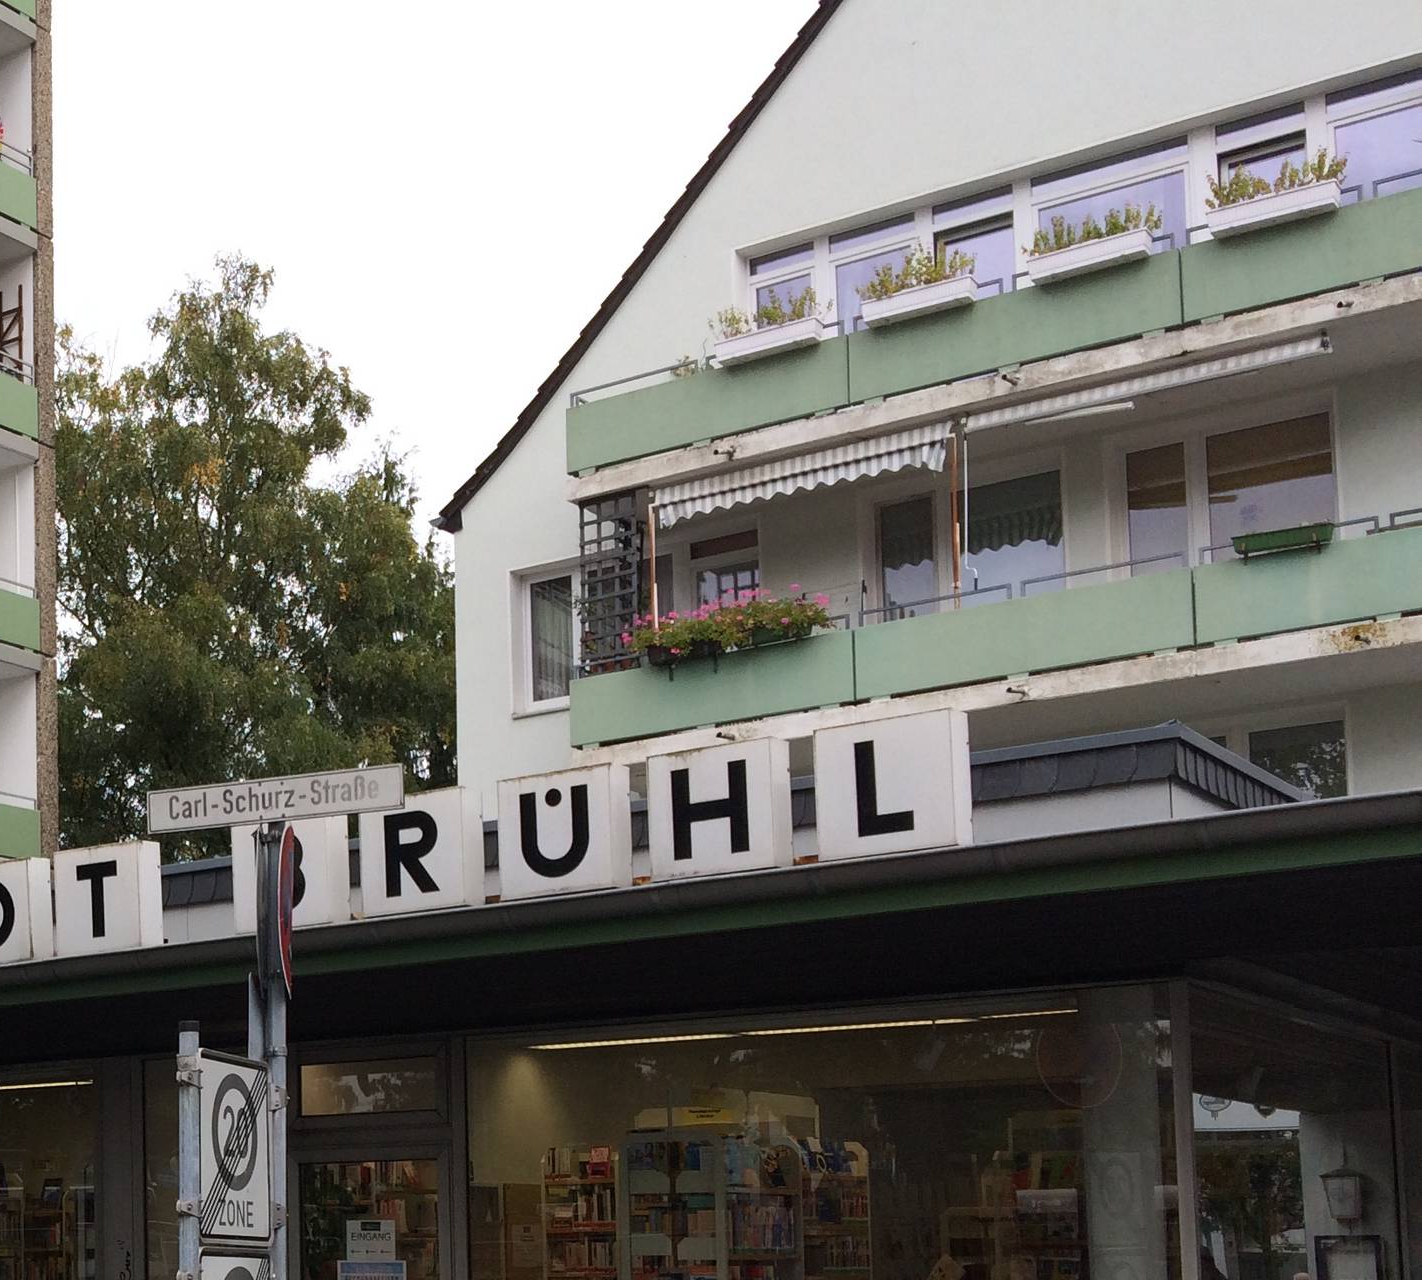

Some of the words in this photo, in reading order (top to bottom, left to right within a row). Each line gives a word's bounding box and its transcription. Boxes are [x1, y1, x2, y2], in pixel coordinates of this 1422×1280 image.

[168, 775, 379, 820] Carl-Schurz-Straße
[219, 1198, 254, 1229] ZONE
[350, 1232, 392, 1242] EINGANG
